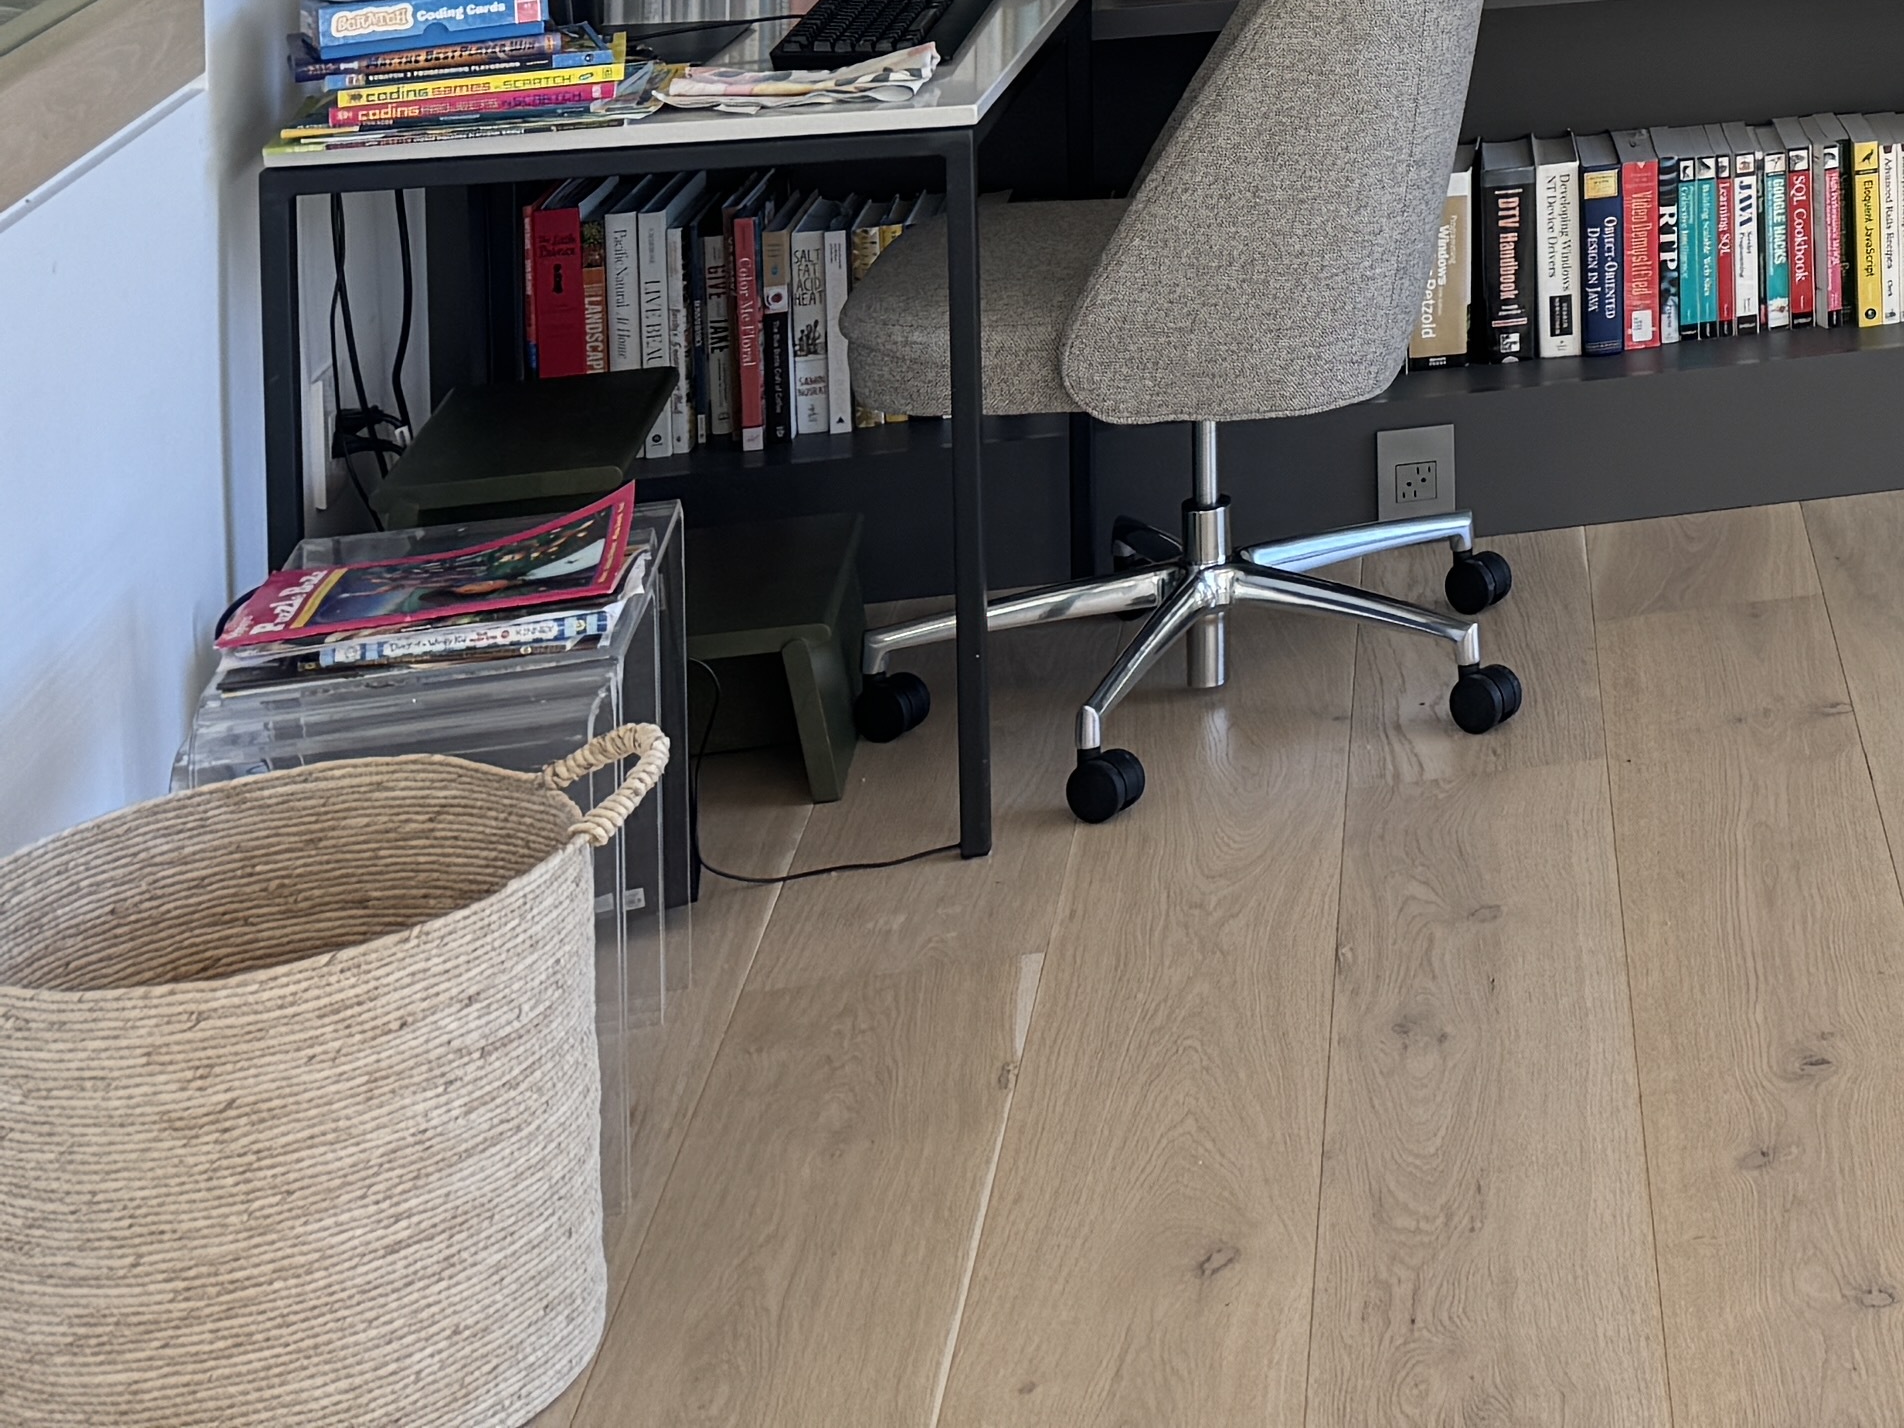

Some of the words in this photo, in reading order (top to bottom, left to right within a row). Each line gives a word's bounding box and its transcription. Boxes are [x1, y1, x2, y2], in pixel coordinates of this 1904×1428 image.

[334, 10, 410, 32] SCRATCH
[417, 8, 461, 22] Coding
[466, 2, 505, 16] Cards
[503, 74, 571, 88] SCRATCH
[1557, 173, 1571, 238] Developing
[1631, 192, 1651, 219] Video
[1718, 183, 1730, 232] Learning
[1737, 181, 1753, 227] JAVA
[1772, 180, 1785, 222] GOOGLE
[1793, 175, 1806, 205] SQL
[1862, 180, 1875, 222] Eloquent
[1498, 198, 1518, 228] DTV
[1547, 195, 1557, 231] Device
[613, 229, 628, 263] Pacific
[1436, 225, 1449, 285] Windows
[1548, 235, 1558, 277] Drivers
[1586, 227, 1599, 268] DESIGN
[1659, 205, 1677, 269] RTP
[1718, 235, 1731, 256] SQL
[1773, 227, 1786, 264] HACKS
[1794, 211, 1807, 281] Cookbook
[1863, 225, 1876, 277] JavaScript
[794, 249, 820, 264] SALT
[798, 263, 817, 278] FAT
[1499, 233, 1518, 299] Handbook
[1561, 243, 1572, 292] Windows
[1603, 217, 1617, 319] OBJECT-ORIENTED
[1631, 221, 1653, 295] Demystified
[615, 267, 628, 308] Natural
[708, 266, 726, 299] GIVE
[737, 258, 753, 296] Color
[796, 277, 820, 293] ACID
[645, 281, 663, 317] LIVE
[794, 289, 823, 306] HEAT
[1587, 288, 1600, 311] JAVA
[709, 320, 728, 353] TAKE
[740, 327, 755, 366] Floral
